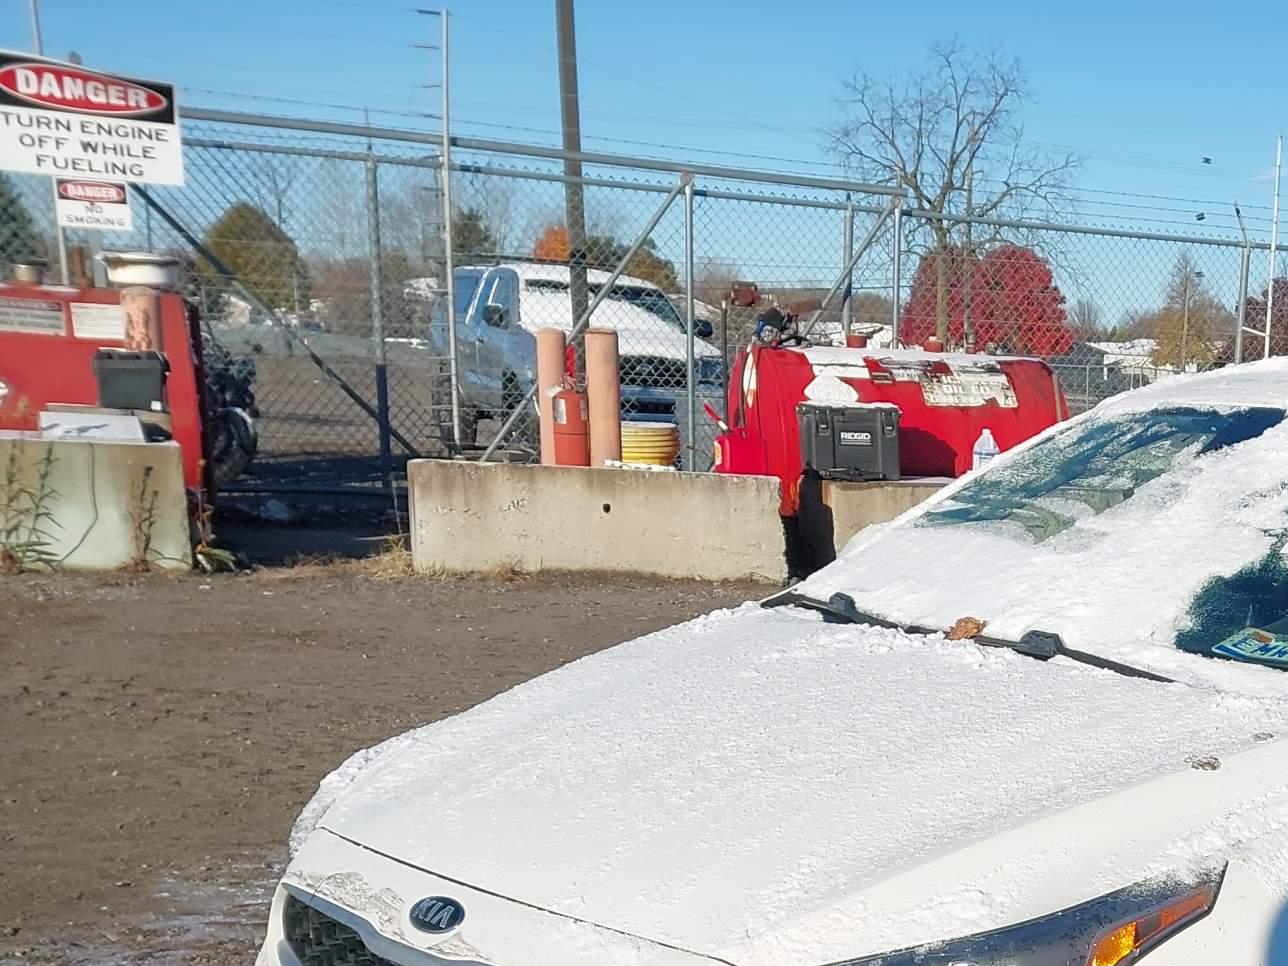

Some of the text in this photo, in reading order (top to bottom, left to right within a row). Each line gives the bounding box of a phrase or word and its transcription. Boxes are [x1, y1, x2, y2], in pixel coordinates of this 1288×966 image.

[15, 68, 149, 108] DANGER
[1, 112, 169, 142] TURN ENGINE
[19, 134, 157, 160] OFF WHILE
[36, 154, 144, 177] FUELING
[66, 183, 117, 199] DANGER
[66, 214, 125, 226] SMOKING
[85, 205, 103, 214] NO
[840, 431, 871, 440] RIDGID
[411, 898, 455, 928] KIA
